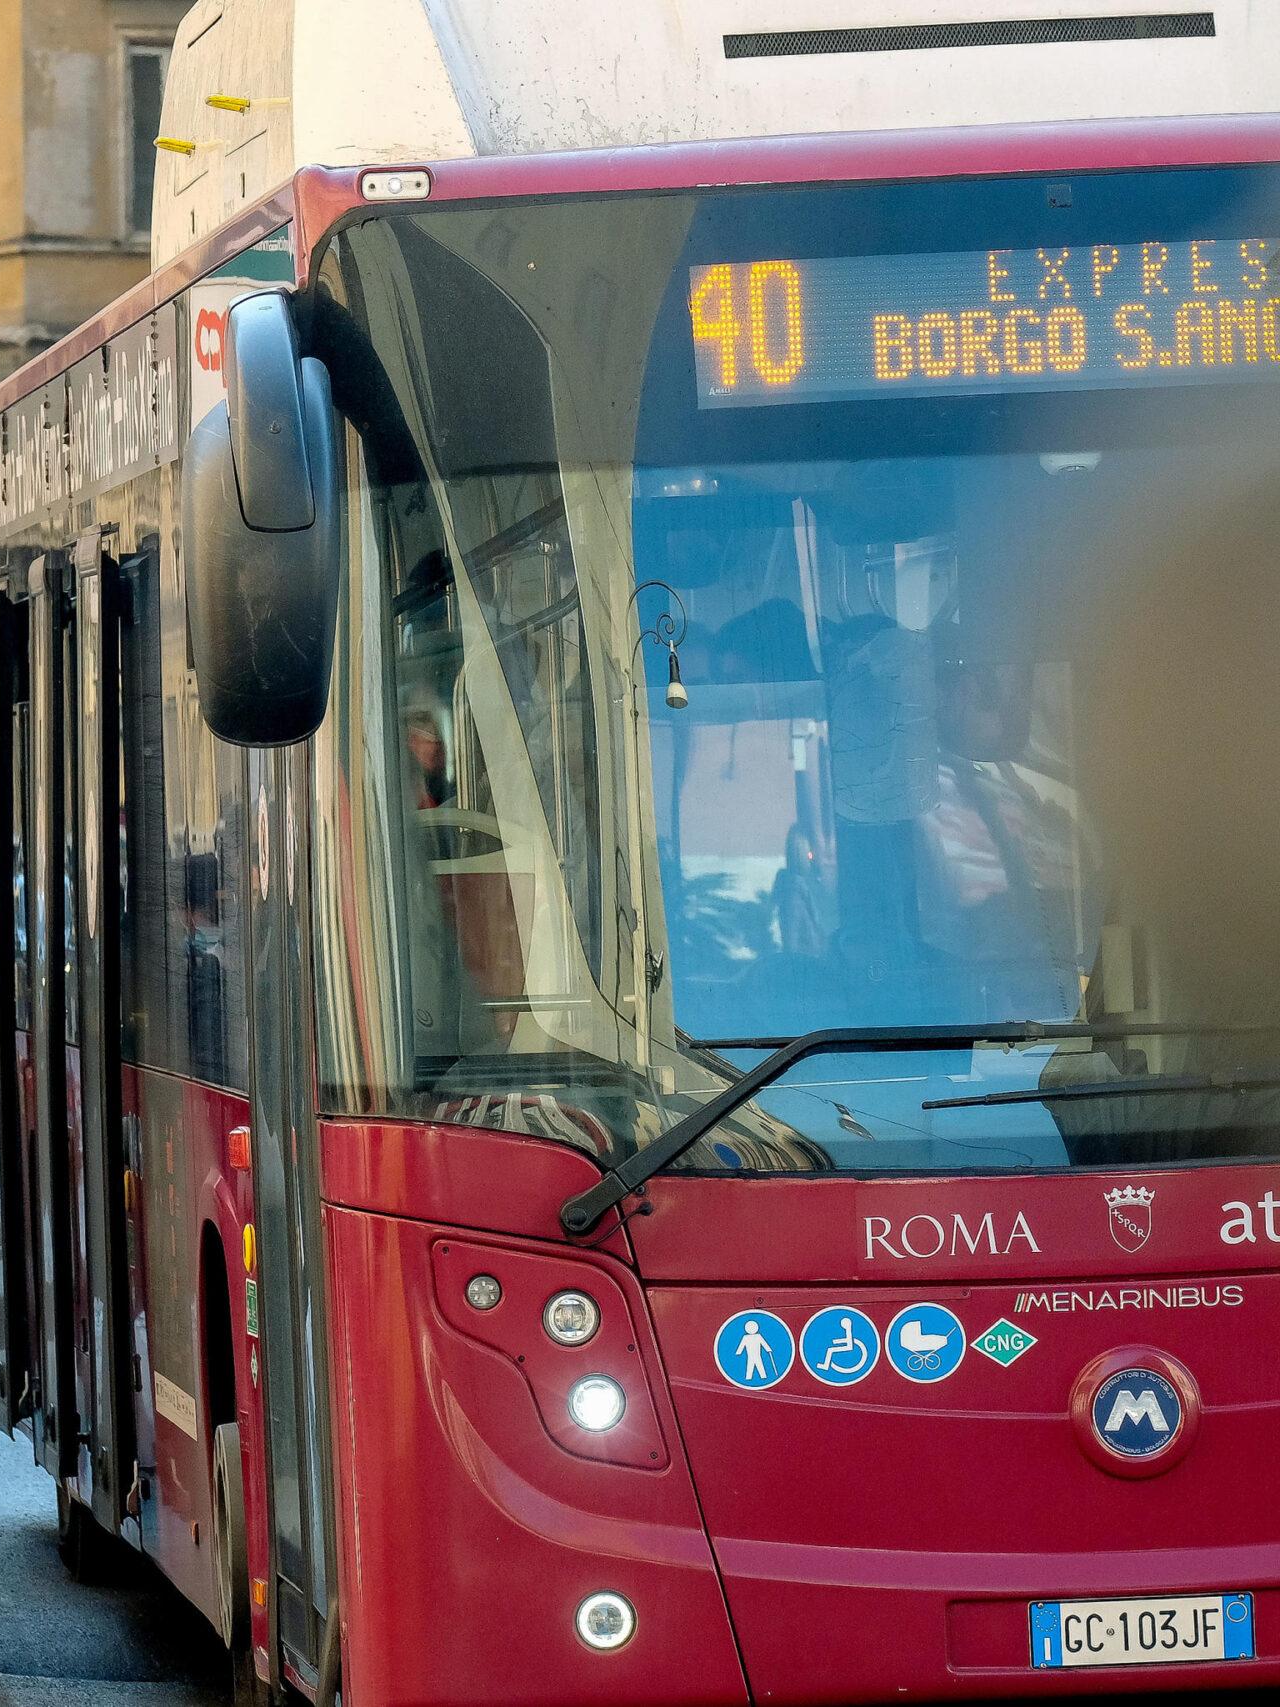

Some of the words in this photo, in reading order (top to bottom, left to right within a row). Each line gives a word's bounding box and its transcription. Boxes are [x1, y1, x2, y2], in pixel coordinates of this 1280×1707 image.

[986, 238, 1268, 303] EXPRES
[689, 259, 804, 388] 40
[873, 306, 1087, 381] BORGO
[863, 1210, 1043, 1261] ROMA
[1219, 1190, 1280, 1245] at
[1024, 1285, 1245, 1313] MENARINIBUS
[983, 1332, 1025, 1354] CNG
[1099, 1372, 1140, 1399] COSTRUTTORI
[1147, 1374, 1175, 1400] AUTOBUS
[1104, 1390, 1171, 1432] M
[1064, 1613, 1105, 1653] GC
[1119, 1608, 1219, 1651] 103JF
